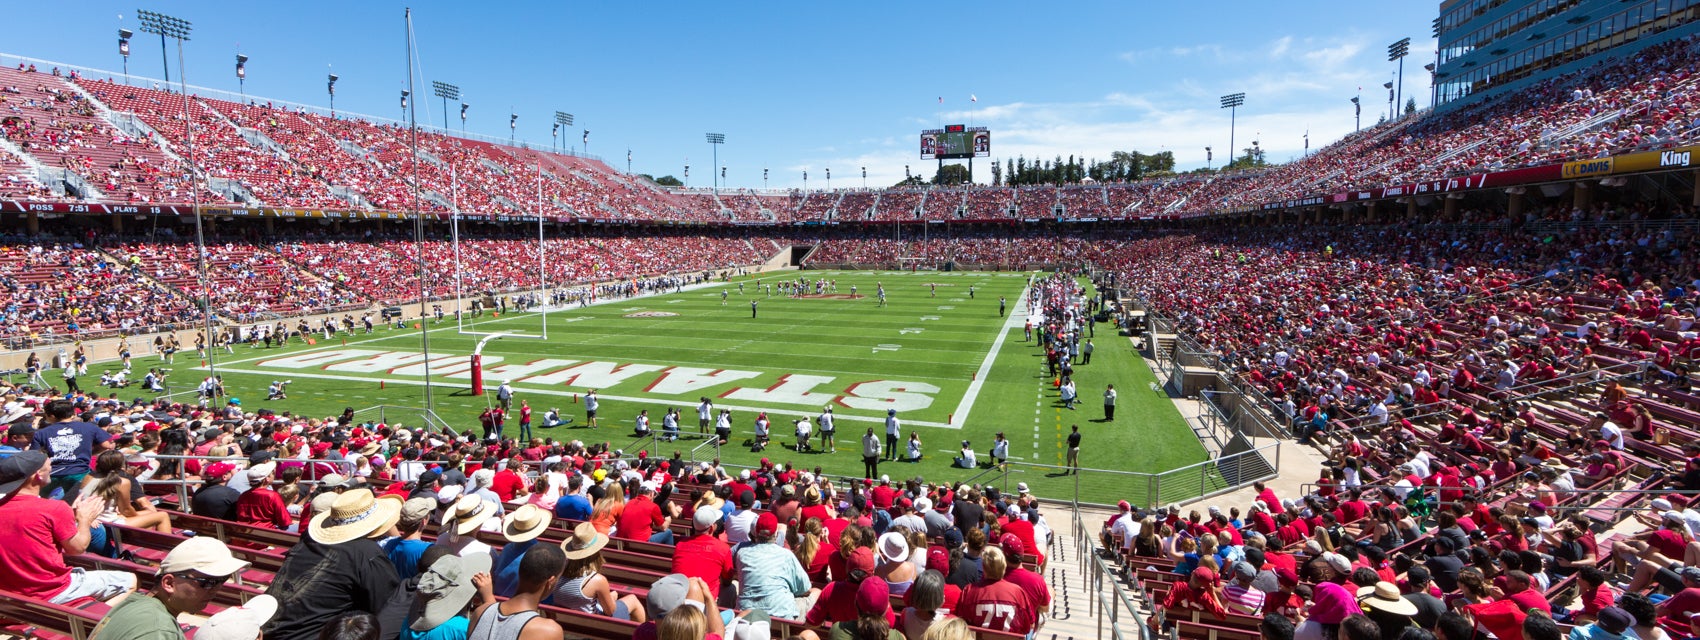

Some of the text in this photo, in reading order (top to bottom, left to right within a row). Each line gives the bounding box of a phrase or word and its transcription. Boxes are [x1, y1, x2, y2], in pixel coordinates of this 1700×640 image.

[1660, 151, 1691, 166] King
[29, 203, 89, 212] POSS 7:51
[255, 350, 942, 412] STANFORD
[975, 603, 1016, 632] 77
